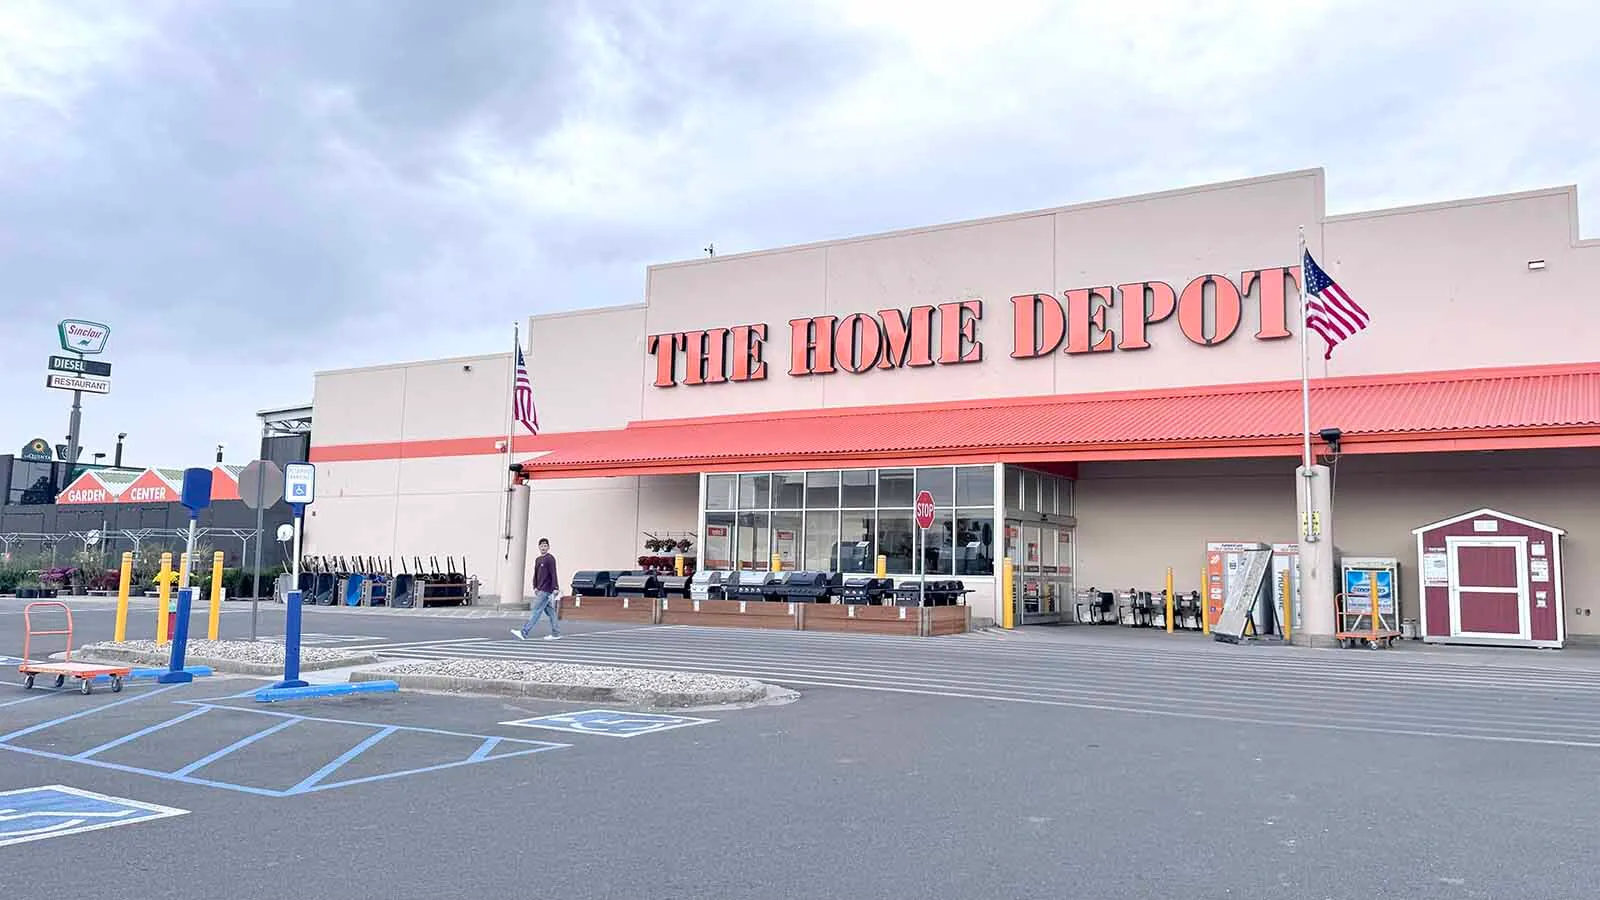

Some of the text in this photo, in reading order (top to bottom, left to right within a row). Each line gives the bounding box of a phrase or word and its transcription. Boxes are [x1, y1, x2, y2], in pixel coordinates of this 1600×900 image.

[68, 325, 102, 339] Sinclair
[648, 266, 1301, 388] THE HOME DEPOT
[54, 359, 85, 371] DIESEL
[54, 377, 107, 390] RESTAURANT
[68, 487, 166, 502] GARDEN CENTER
[917, 503, 933, 518] STOP
